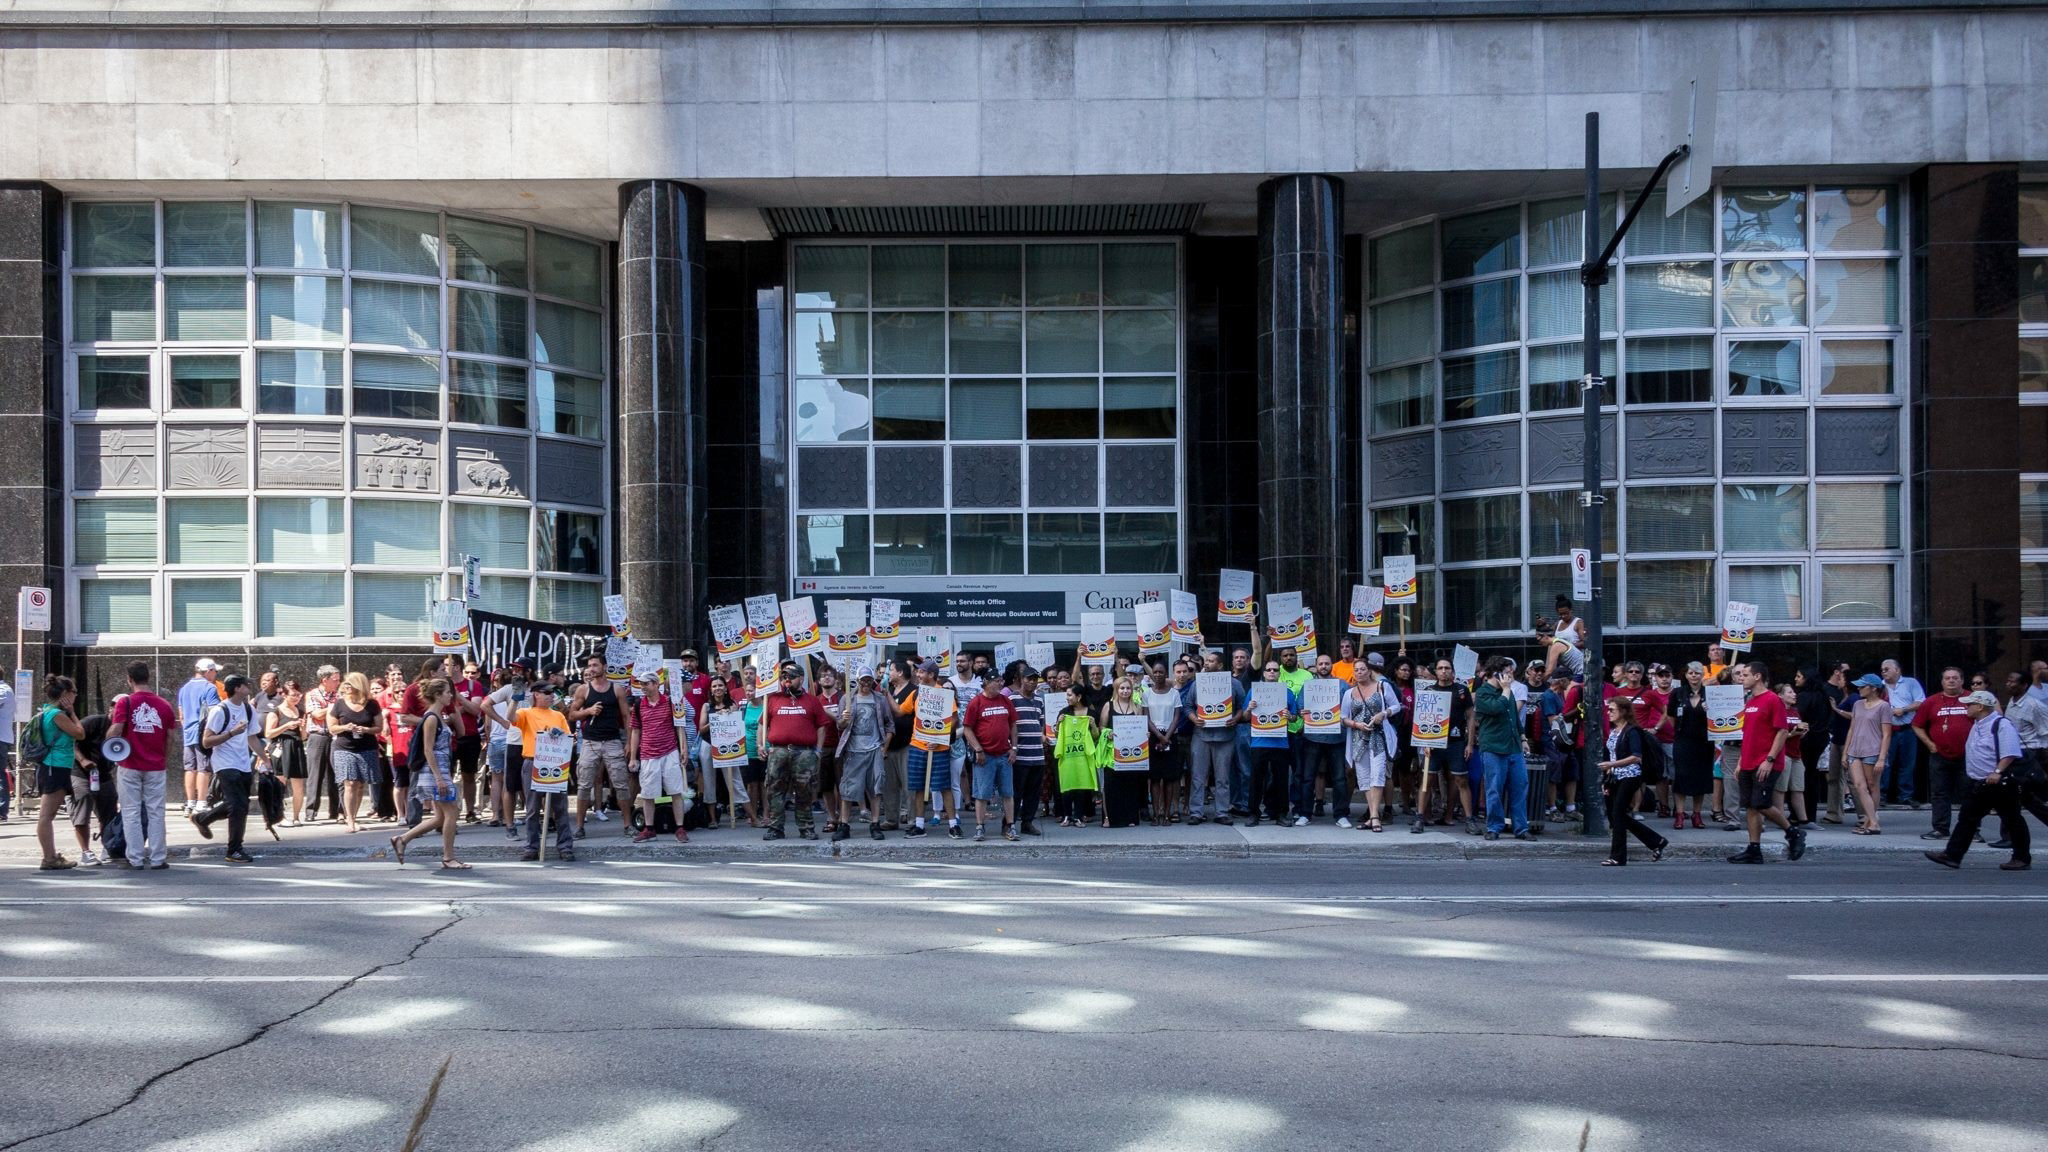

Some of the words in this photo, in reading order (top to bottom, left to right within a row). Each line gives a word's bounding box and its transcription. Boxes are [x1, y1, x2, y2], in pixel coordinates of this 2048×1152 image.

[959, 610, 1007, 619] René-Lévesque
[1200, 675, 1230, 685] STRIKE
[1307, 684, 1339, 693] STRIKE
